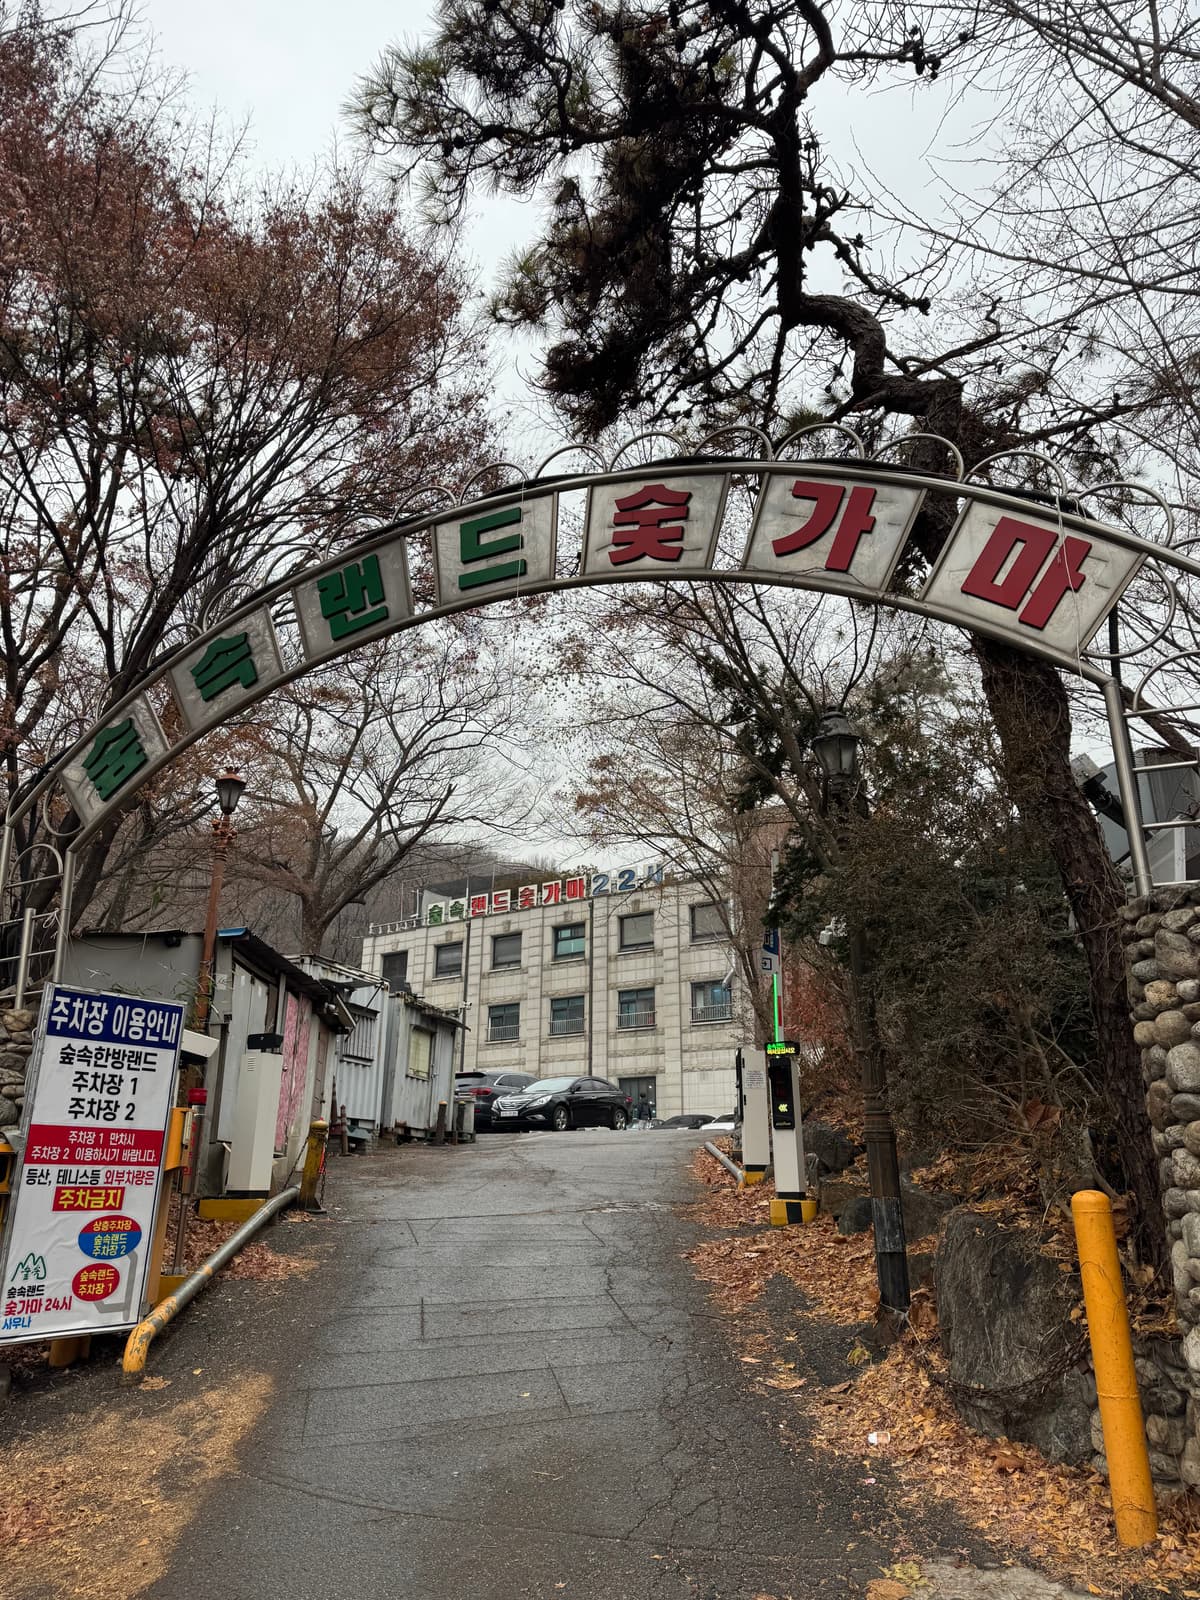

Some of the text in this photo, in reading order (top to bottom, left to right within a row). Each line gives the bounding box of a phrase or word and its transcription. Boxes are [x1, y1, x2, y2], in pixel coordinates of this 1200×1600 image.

[607, 480, 1094, 631] 숯가마
[519, 877, 585, 908] 숯가마
[50, 995, 180, 1044] 주차장 이용안내
[59, 1043, 158, 1072] 숲속한방랜드
[72, 1071, 138, 1096] 주차장 1
[68, 1097, 136, 1122] 주차장 2
[68, 1131, 96, 1146] 주차장
[109, 1132, 136, 1146] 만차시
[31, 1146, 61, 1161] 주차장
[62, 1149, 70, 1160] 2
[75, 1147, 120, 1162] 이용하시기
[25, 1168, 155, 1187] 등산, 테니스등 외부차량은
[58, 1188, 122, 1209] 주차금지
[92, 1245, 126, 1257] 주차장 2
[79, 1268, 115, 1282] 숲속랜드
[6, 1284, 45, 1299] 숲속랜드
[78, 1283, 105, 1296] 주차장
[4, 1296, 73, 1316] 숯가마 24시
[1, 1316, 32, 1330] 사우나
